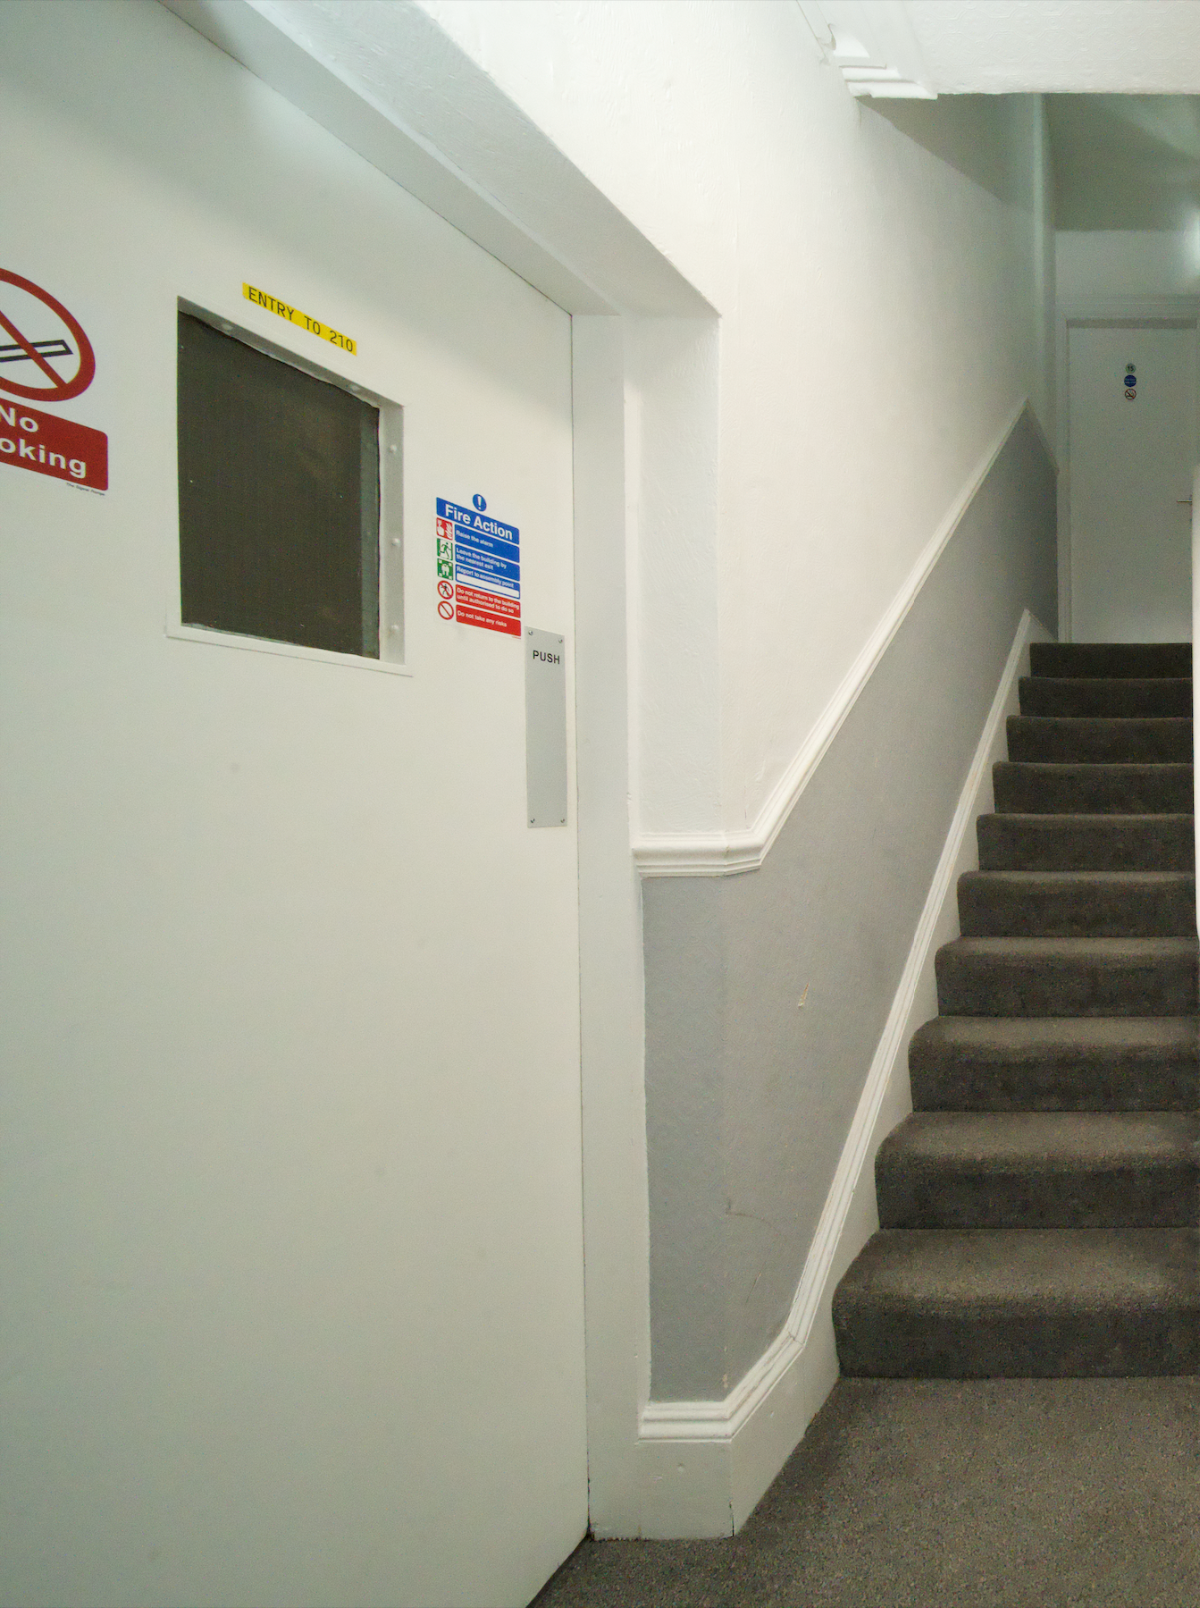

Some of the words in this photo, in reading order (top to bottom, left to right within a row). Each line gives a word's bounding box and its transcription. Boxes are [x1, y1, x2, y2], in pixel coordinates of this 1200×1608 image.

[248, 286, 294, 321] ENTRY
[304, 315, 320, 335] TO
[329, 330, 353, 352] 210
[0, 403, 39, 433] No
[0, 437, 87, 479] oking
[445, 503, 471, 525] Fire
[473, 515, 513, 541] Action
[456, 529, 470, 540] Raise
[470, 534, 480, 543] the
[480, 539, 494, 548] alarm
[456, 547, 472, 557] Leave
[472, 552, 481, 560] the
[480, 555, 500, 567] building
[500, 561, 507, 569] by
[465, 557, 484, 567] nearest
[484, 562, 494, 570] exit
[456, 565, 474, 576] Report
[479, 573, 502, 586] assembly
[501, 579, 514, 588] point
[456, 594, 469, 602] until
[456, 587, 465, 595] Do
[473, 592, 489, 601] return
[493, 597, 502, 605] the
[501, 599, 520, 611] building
[457, 609, 465, 617] Do
[474, 614, 486, 622] take
[485, 617, 495, 626] any
[495, 619, 508, 628] risks
[532, 649, 561, 665] PUSH
